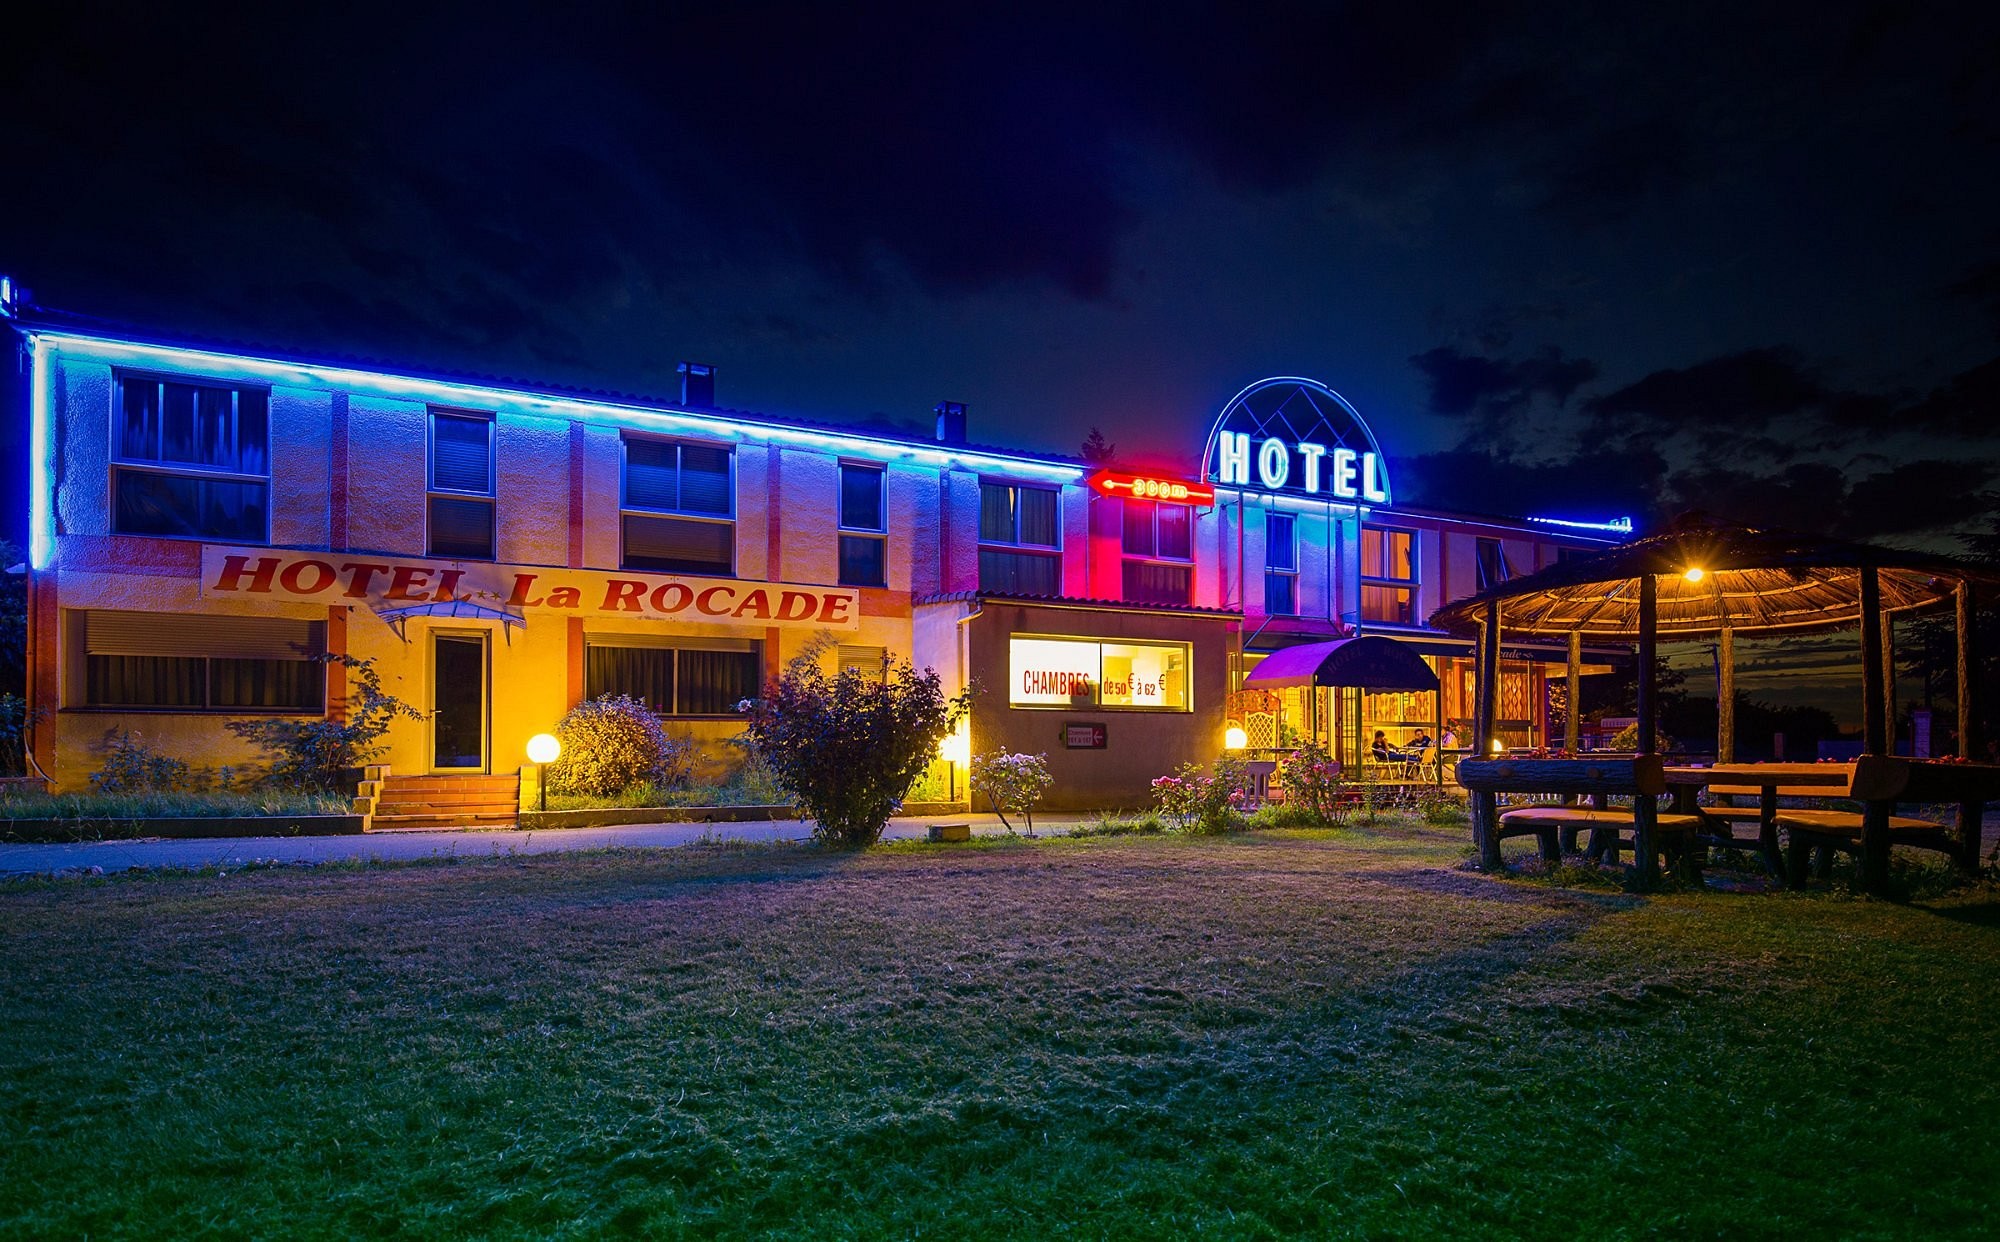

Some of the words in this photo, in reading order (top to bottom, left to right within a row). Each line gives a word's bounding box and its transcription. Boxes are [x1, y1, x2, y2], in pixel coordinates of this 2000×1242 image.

[1132, 479, 1188, 499] 300m
[1219, 430, 1386, 502] HOTEL
[212, 555, 472, 601] HOTEL
[505, 573, 582, 608] La
[598, 579, 853, 624] ROCADE
[1023, 670, 1090, 696] CHAMBRES
[1104, 677, 1114, 695] de
[1115, 683, 1126, 695] 50
[1137, 679, 1142, 696] à
[1145, 683, 1156, 696] 62
